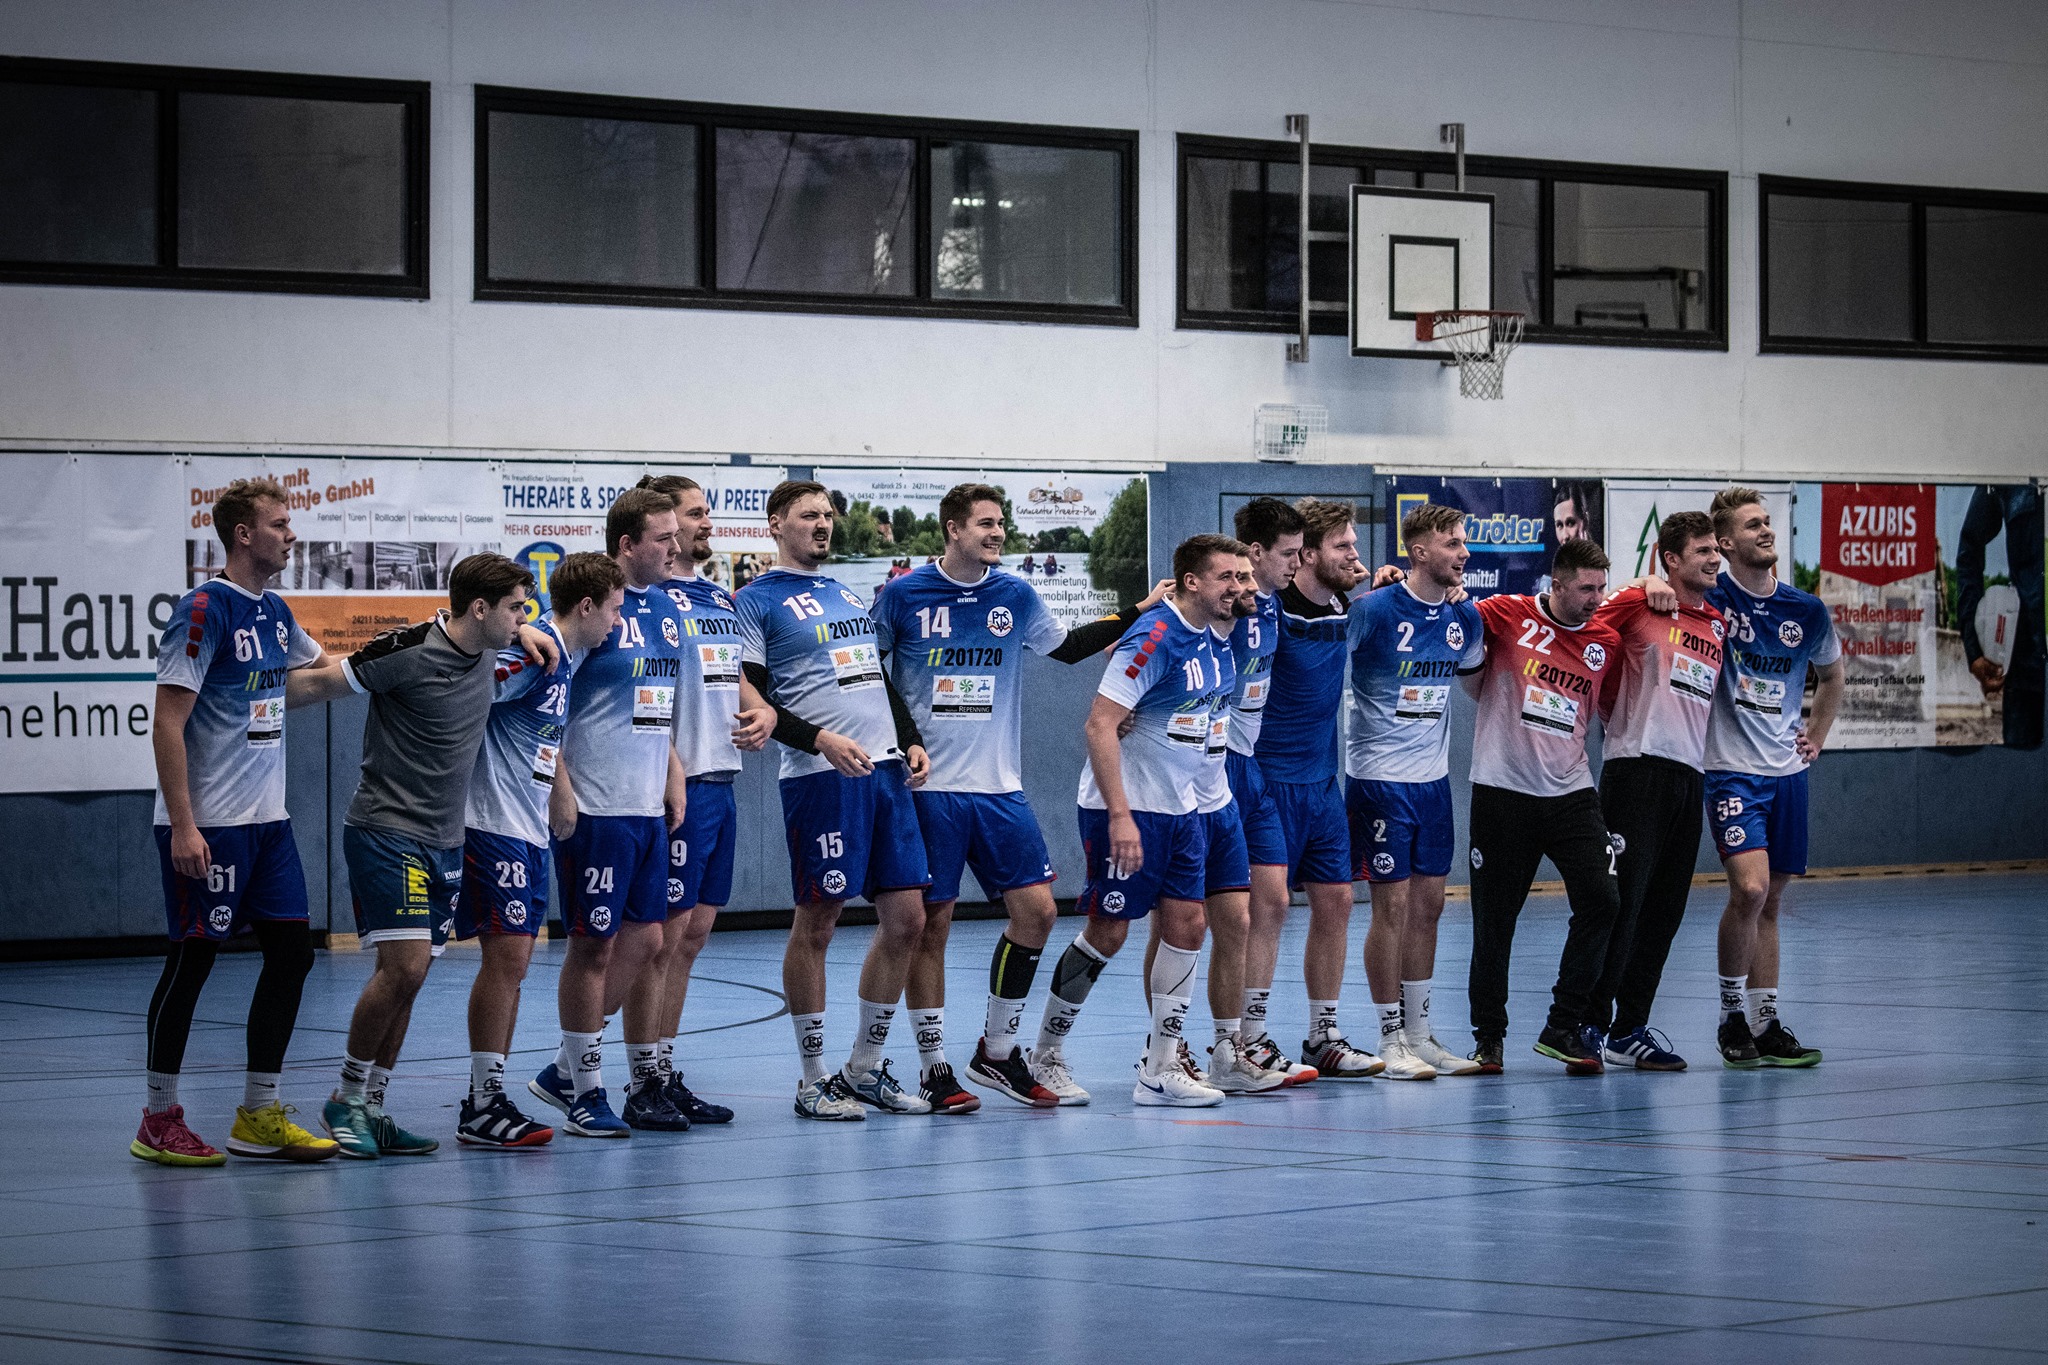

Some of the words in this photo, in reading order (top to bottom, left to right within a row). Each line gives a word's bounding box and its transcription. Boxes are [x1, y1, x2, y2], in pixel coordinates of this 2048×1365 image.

[283, 467, 310, 487] mit
[325, 477, 375, 502] GmbH
[580, 486, 592, 509] &
[724, 488, 772, 511] PREET
[317, 513, 342, 521] Fenster
[348, 513, 367, 521] Türen
[464, 514, 494, 523] Glaserei
[504, 524, 530, 535] MEHR
[1839, 505, 1917, 537] AZUBIS
[1840, 541, 1917, 567] GESUCHT
[667, 588, 692, 612] 9
[782, 592, 825, 621] 15
[1087, 590, 1117, 601] Preetz
[915, 606, 952, 638] 14
[1081, 605, 1118, 616] Kirchsee
[1723, 606, 1756, 643] 55
[234, 625, 263, 662] 61
[618, 616, 645, 649] 24
[1247, 617, 1261, 649] 5
[1396, 621, 1415, 652] 2
[1517, 618, 1556, 656] 22
[1841, 636, 1917, 656] Kanalbauer
[1182, 657, 1204, 691] 10
[536, 683, 567, 716] 28
[1717, 796, 1744, 821] 55
[1373, 819, 1387, 842] 2
[670, 839, 688, 867] 9
[816, 831, 844, 859] 15
[207, 864, 236, 893] 61
[495, 860, 528, 889] 28
[584, 866, 615, 894] 24
